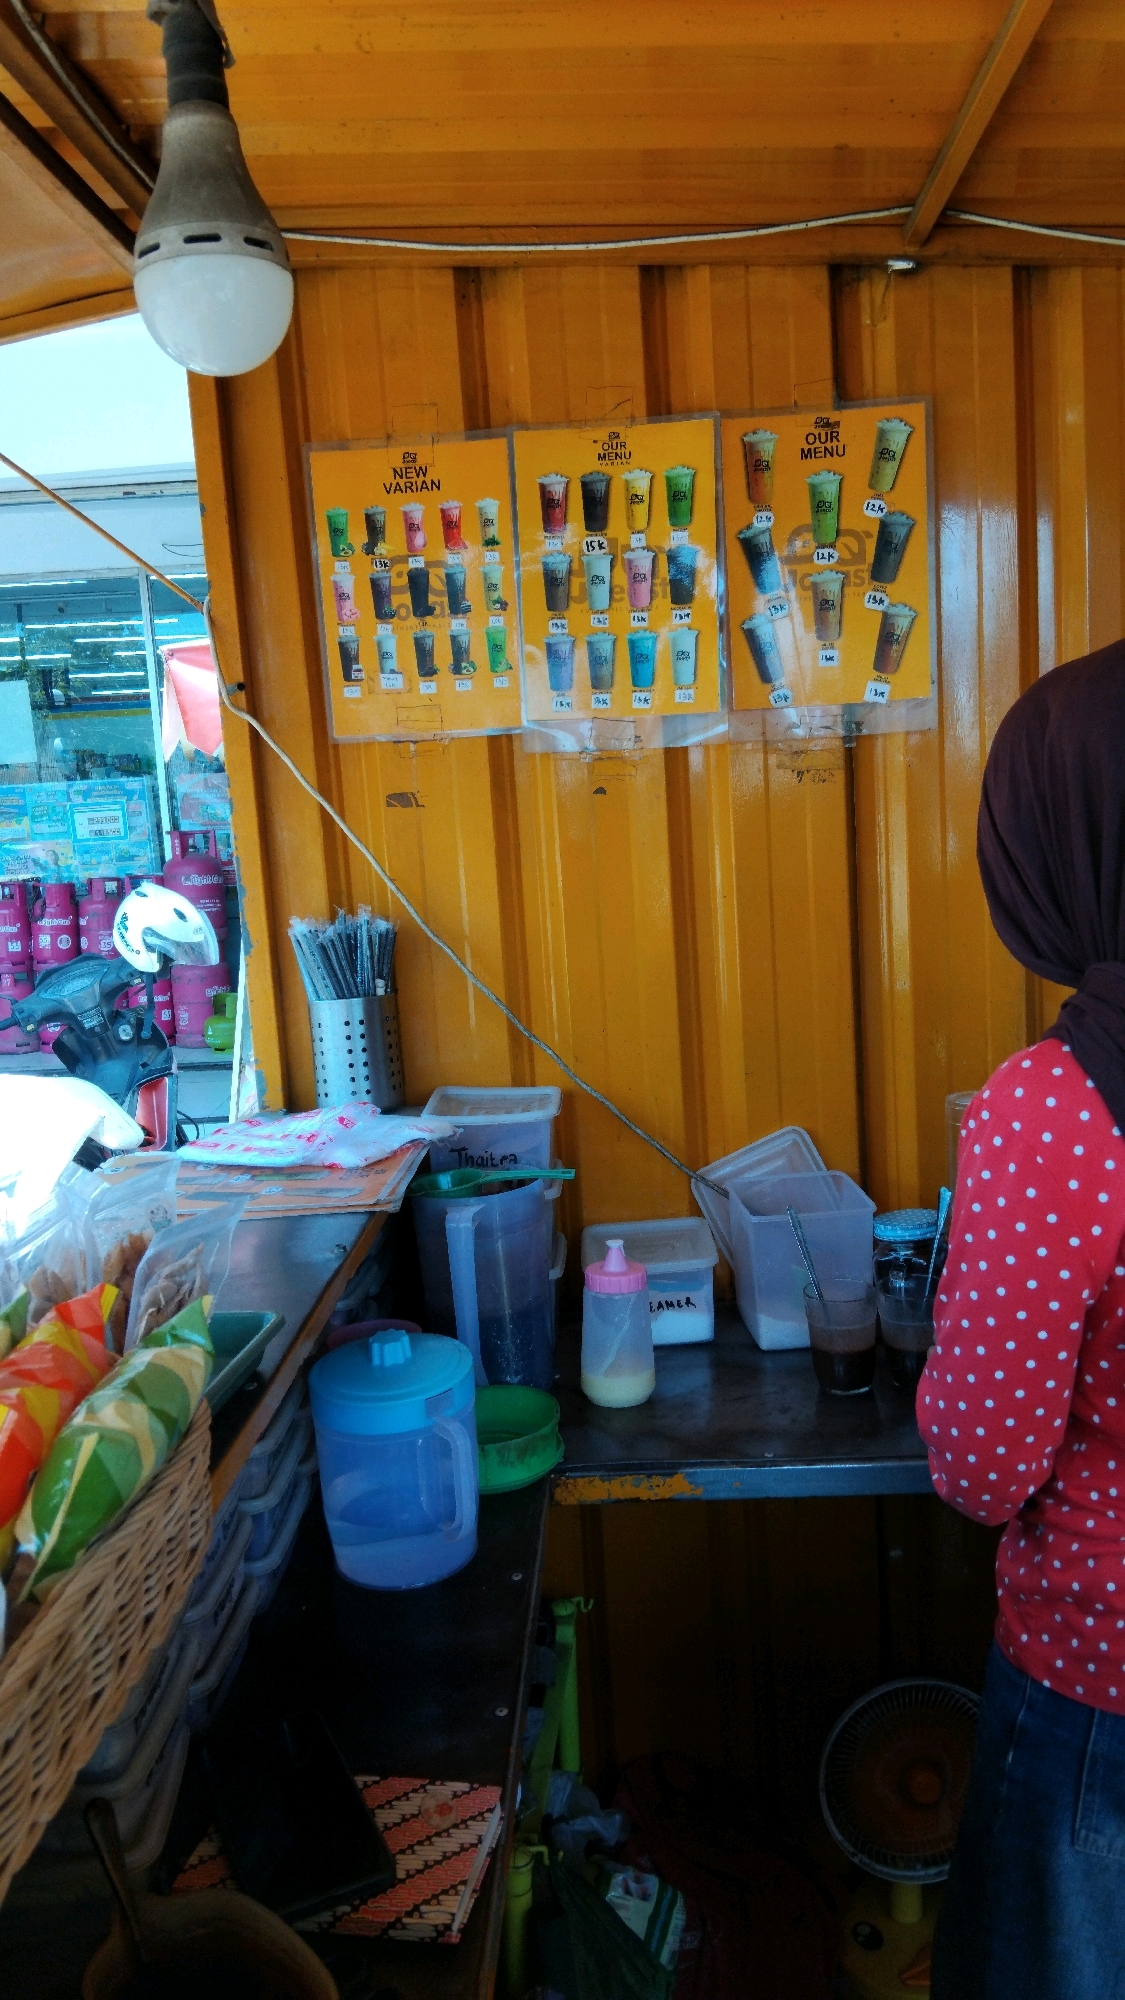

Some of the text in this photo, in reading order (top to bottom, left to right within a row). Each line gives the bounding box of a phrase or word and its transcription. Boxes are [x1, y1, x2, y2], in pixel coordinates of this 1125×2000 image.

[601, 440, 628, 451] OUR
[804, 430, 841, 446] OUR
[596, 450, 632, 462] MENU
[799, 444, 847, 461] MENU
[391, 465, 429, 480] NEW
[382, 478, 442, 495] VARIAN
[648, 1296, 697, 1313] EAMER
